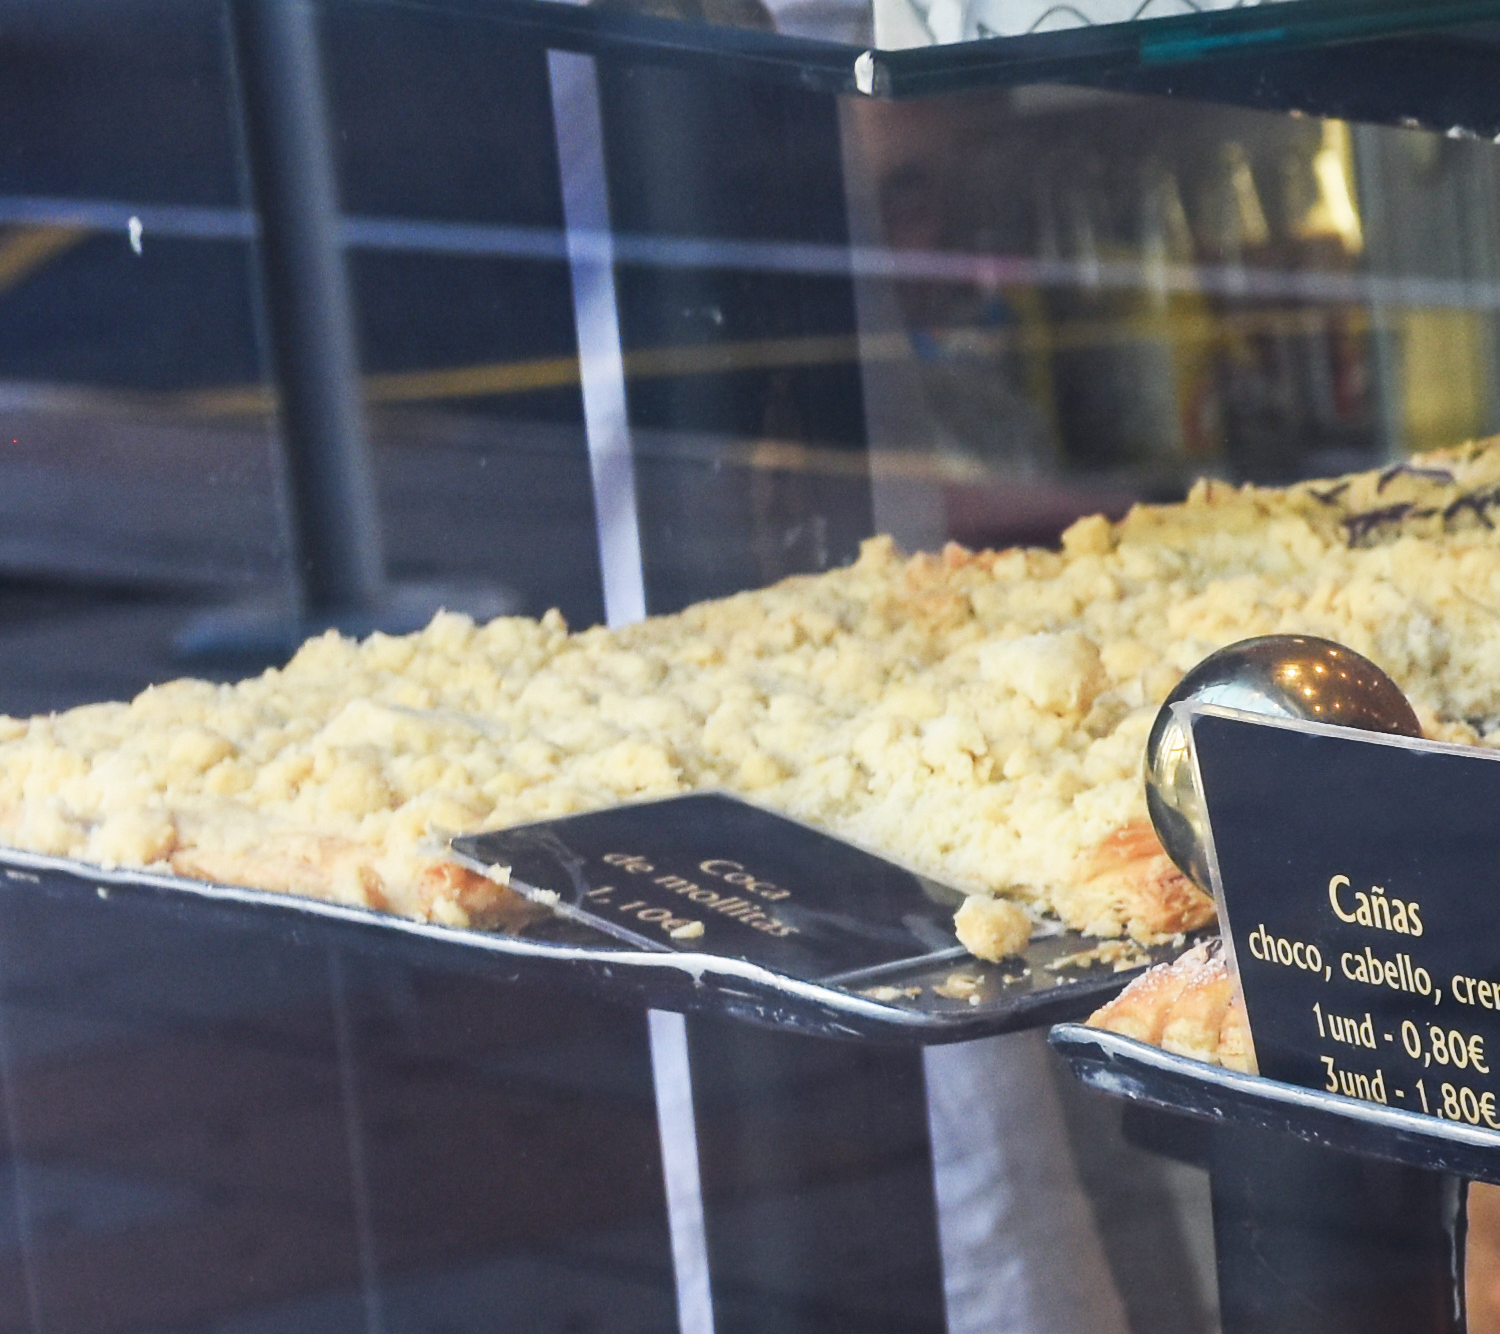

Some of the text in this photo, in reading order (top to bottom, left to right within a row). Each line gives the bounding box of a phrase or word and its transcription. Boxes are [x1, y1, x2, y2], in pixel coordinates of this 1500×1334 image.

[603, 853, 799, 936] de mollitas
[700, 859, 791, 900] Coca
[1328, 874, 1424, 937] Cañas
[1248, 923, 1332, 982] choco,
[1340, 948, 1442, 1005] cabello,
[1313, 1002, 1376, 1049] 1und
[1402, 1019, 1490, 1074] 0,80€
